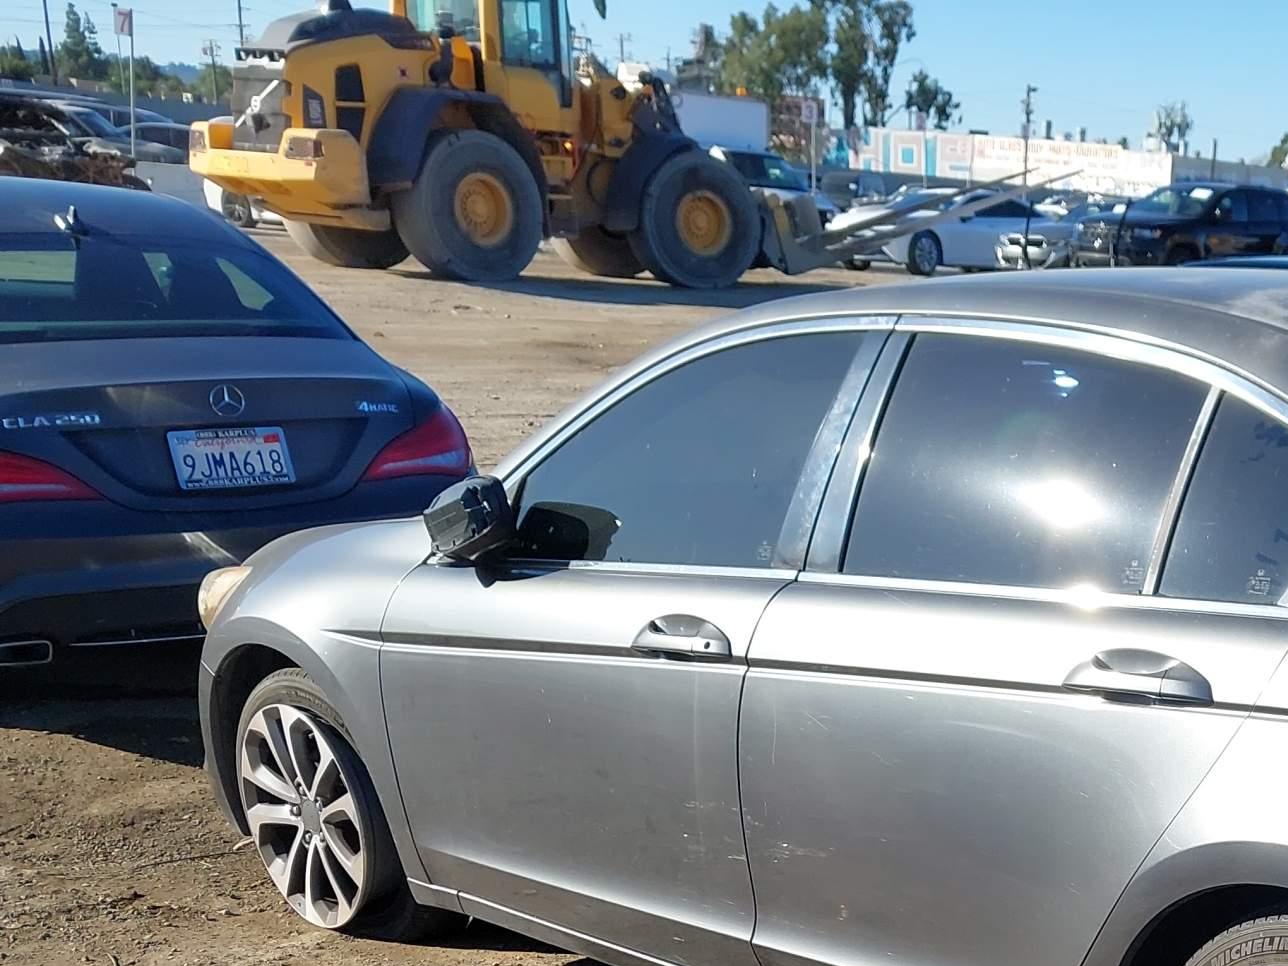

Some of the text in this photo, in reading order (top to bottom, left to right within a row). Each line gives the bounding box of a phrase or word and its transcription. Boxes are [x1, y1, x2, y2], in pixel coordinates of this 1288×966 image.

[117, 11, 129, 32] 7
[2, 414, 100, 429] CLA 250
[183, 450, 284, 480] 9JMA618
